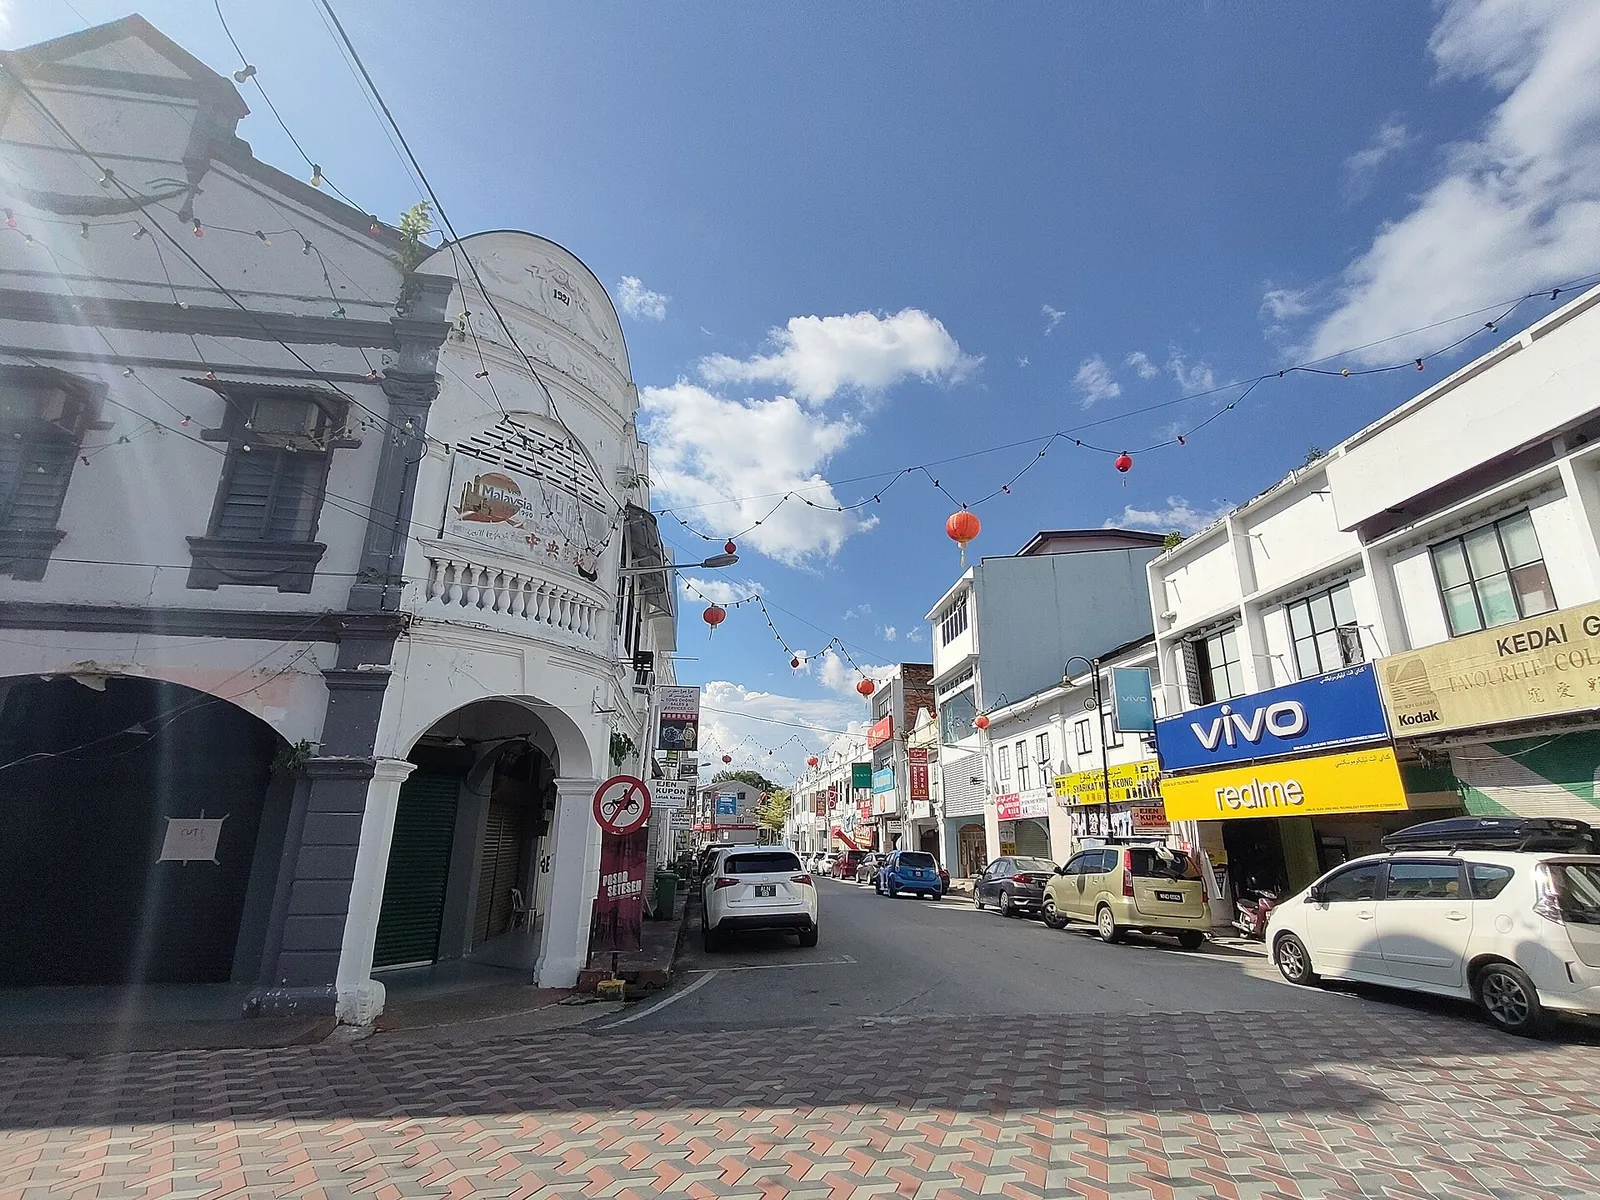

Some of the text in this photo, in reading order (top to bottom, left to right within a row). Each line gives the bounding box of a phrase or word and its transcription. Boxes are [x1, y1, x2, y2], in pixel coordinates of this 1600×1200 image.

[552, 288, 571, 307] 1921
[482, 484, 533, 511] Malaysia
[1496, 623, 1569, 657] KEDAI
[1450, 658, 1546, 693] FAVOURITE
[1121, 694, 1148, 703] vivo
[1190, 700, 1308, 751] vivo
[1398, 709, 1440, 726] Kodak
[655, 787, 686, 795] KUPON
[1072, 781, 1098, 794] SYARIKAT
[1111, 775, 1134, 788] KEONG
[1214, 777, 1305, 812] realme
